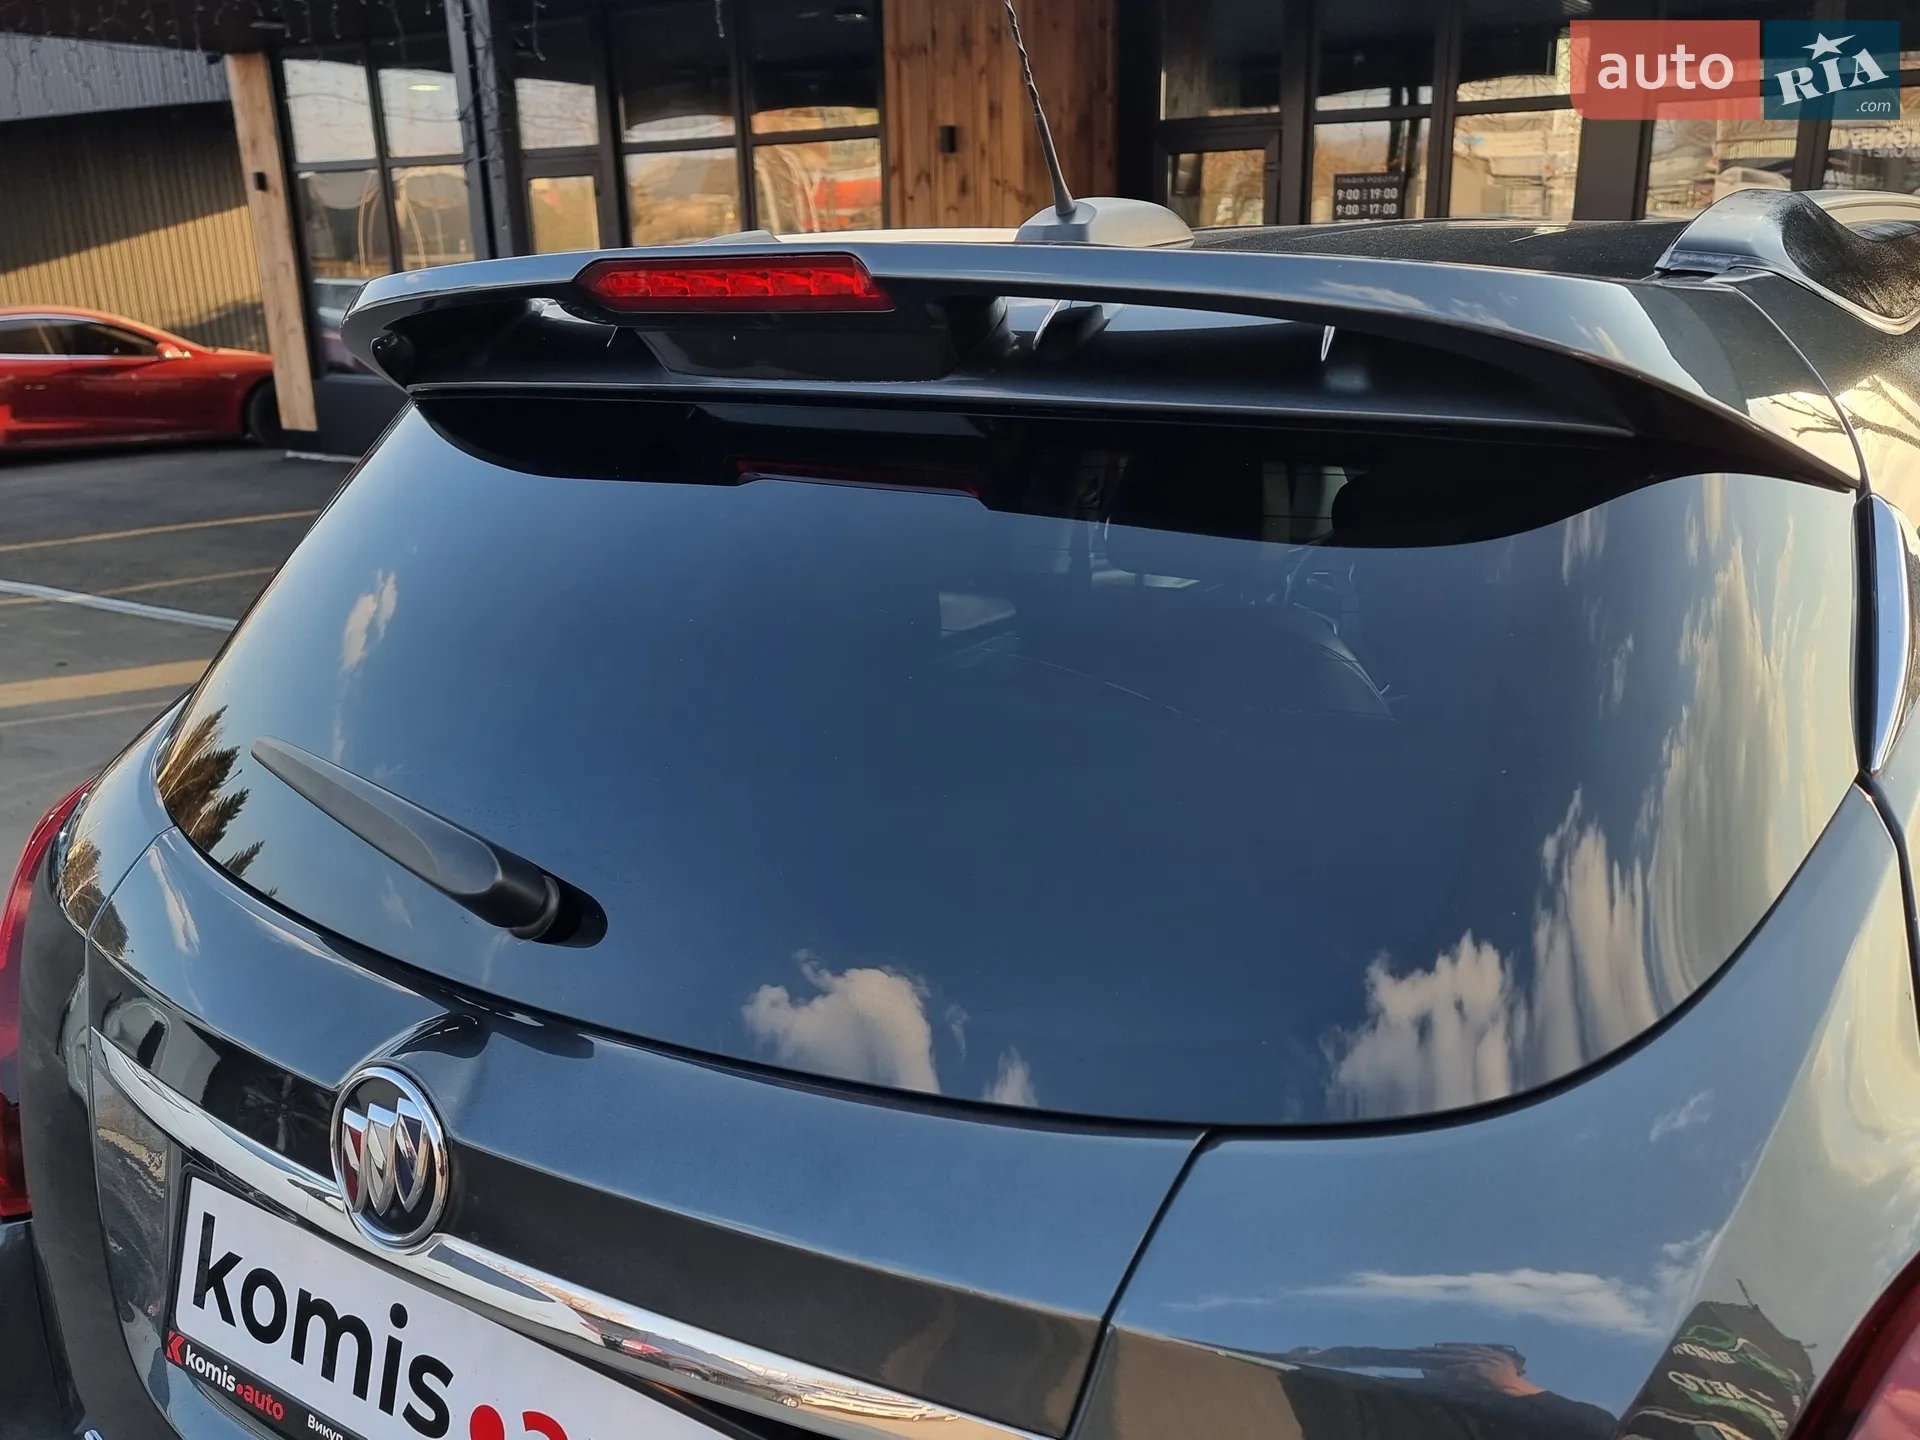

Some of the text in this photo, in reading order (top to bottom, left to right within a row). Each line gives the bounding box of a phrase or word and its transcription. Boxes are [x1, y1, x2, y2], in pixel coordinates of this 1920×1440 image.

[1337, 188, 1361, 200] 9:00
[1370, 187, 1398, 200] 19:00
[1336, 203, 1360, 215] 9:00
[1369, 203, 1397, 215] 17:00
